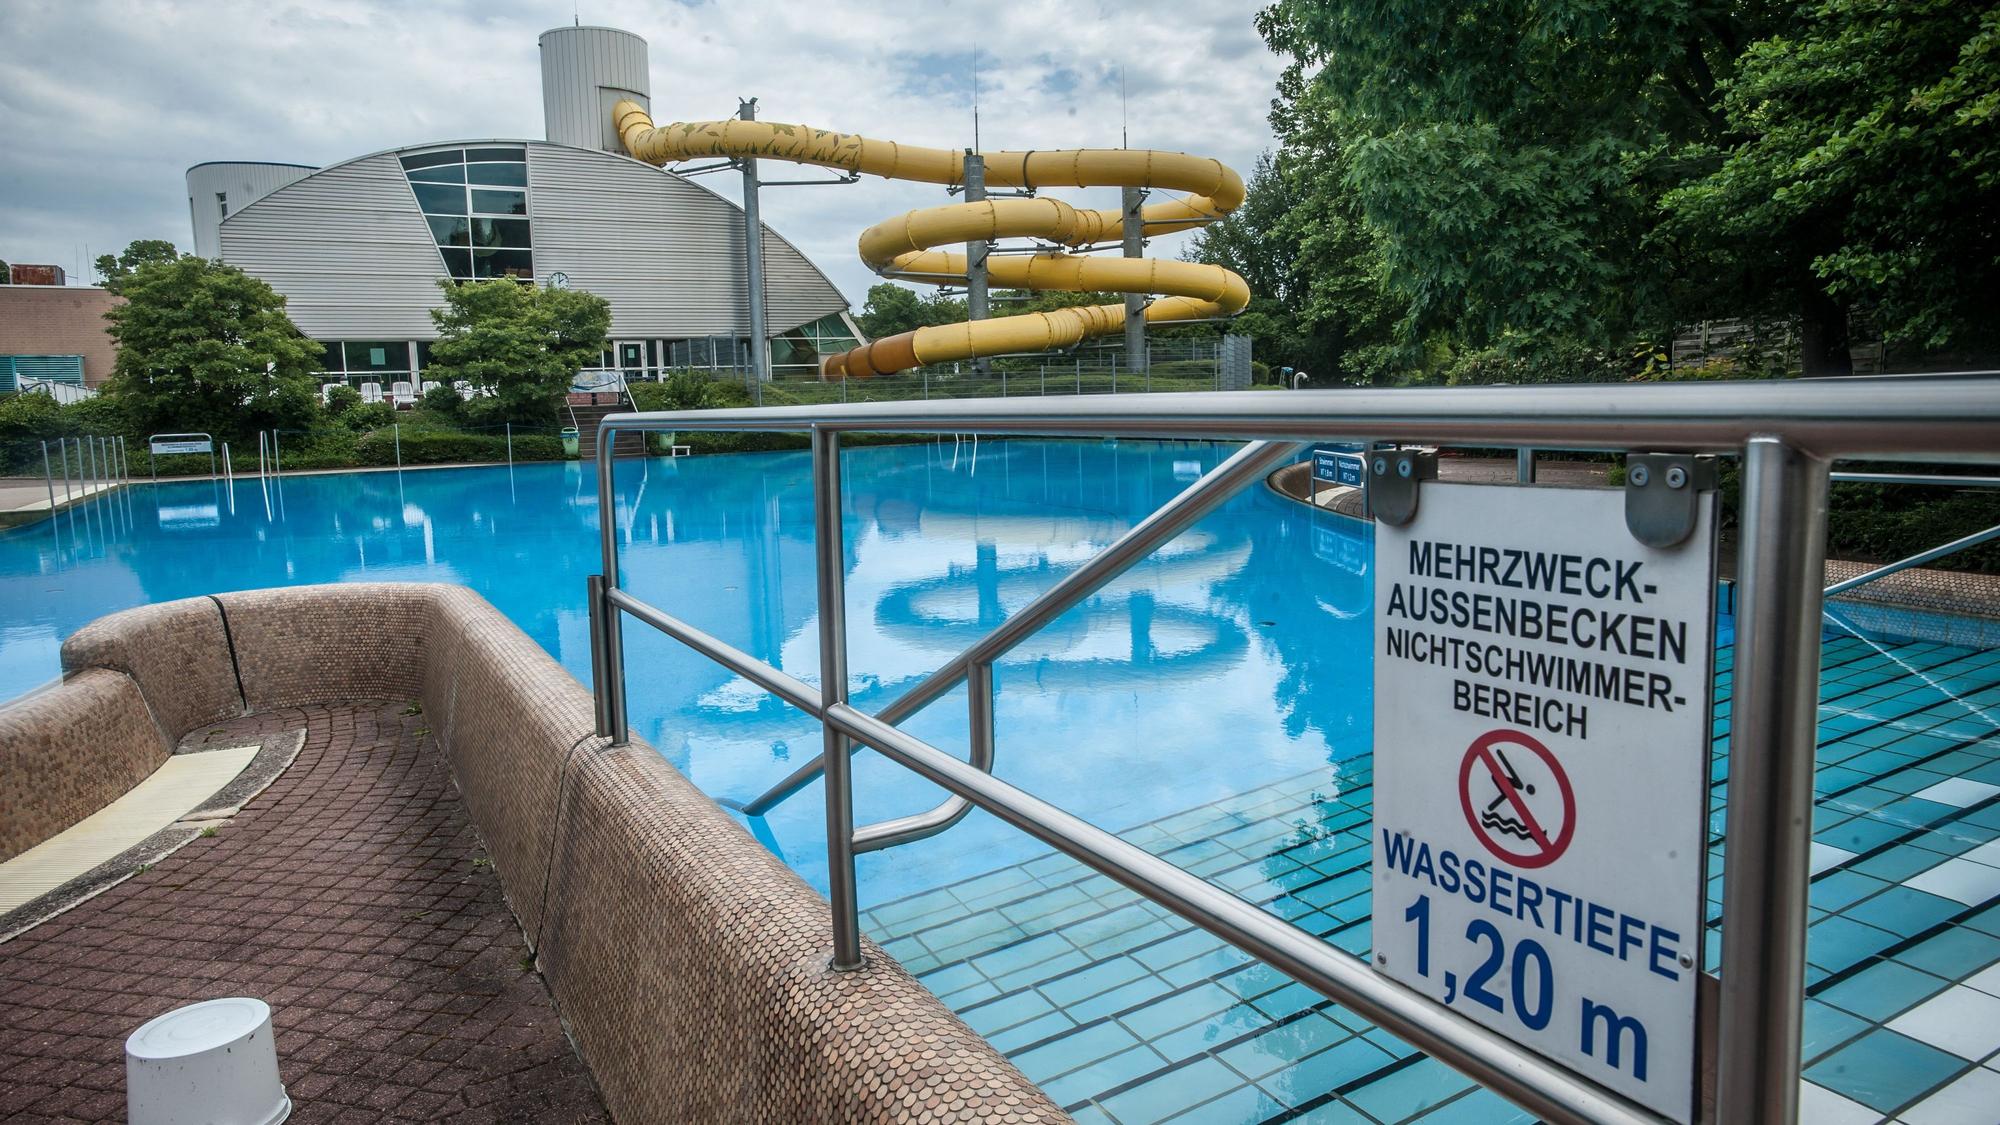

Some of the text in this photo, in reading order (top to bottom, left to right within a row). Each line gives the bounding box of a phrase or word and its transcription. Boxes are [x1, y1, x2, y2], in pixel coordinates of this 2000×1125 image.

[1409, 540, 1657, 603] MEHRZWECK-
[1387, 583, 1687, 664] AUSSENBECKEN
[1387, 626, 1686, 712] NICHTSCHWIMMER-
[1453, 679, 1587, 740] BEREICH
[1382, 827, 1680, 982] WASSERTIEFE
[1405, 894, 1648, 1083] 1,20 m
